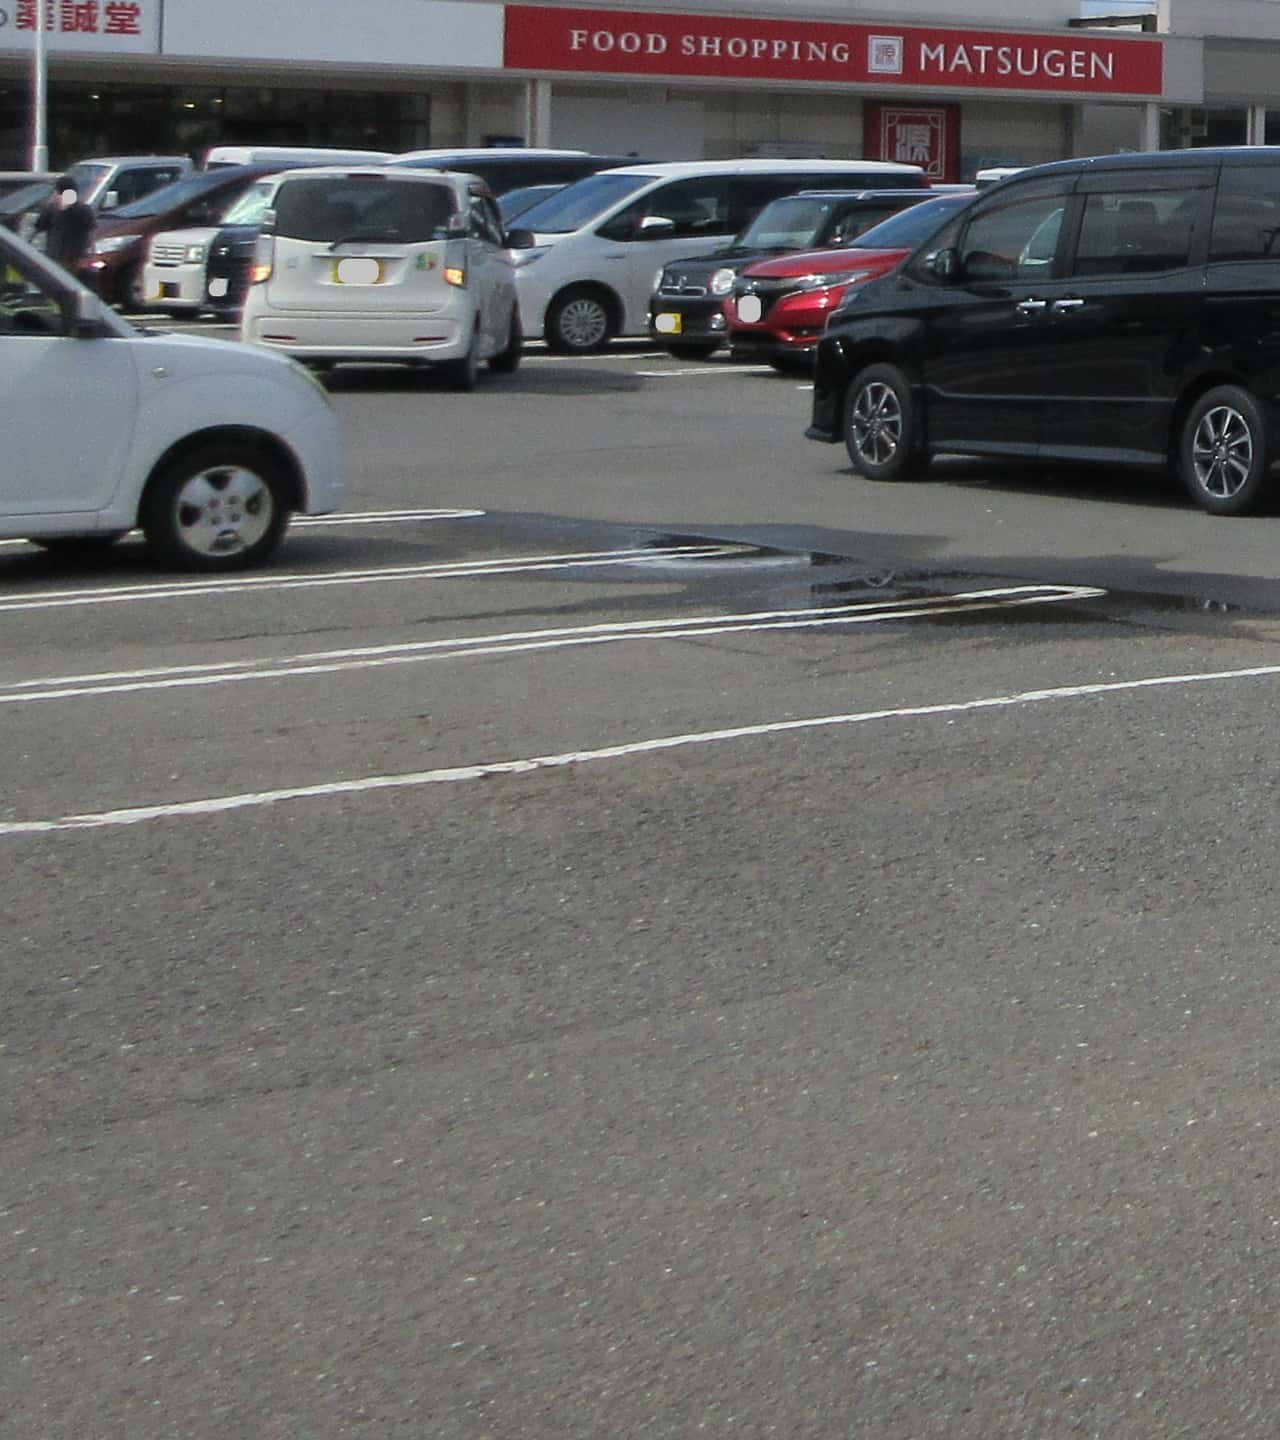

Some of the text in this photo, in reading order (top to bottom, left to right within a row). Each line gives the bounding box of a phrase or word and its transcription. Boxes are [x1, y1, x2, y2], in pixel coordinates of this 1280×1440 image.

[569, 29, 667, 54] FOOD
[681, 35, 850, 62] SHOPPING
[919, 42, 1114, 80] MATSUGEN
